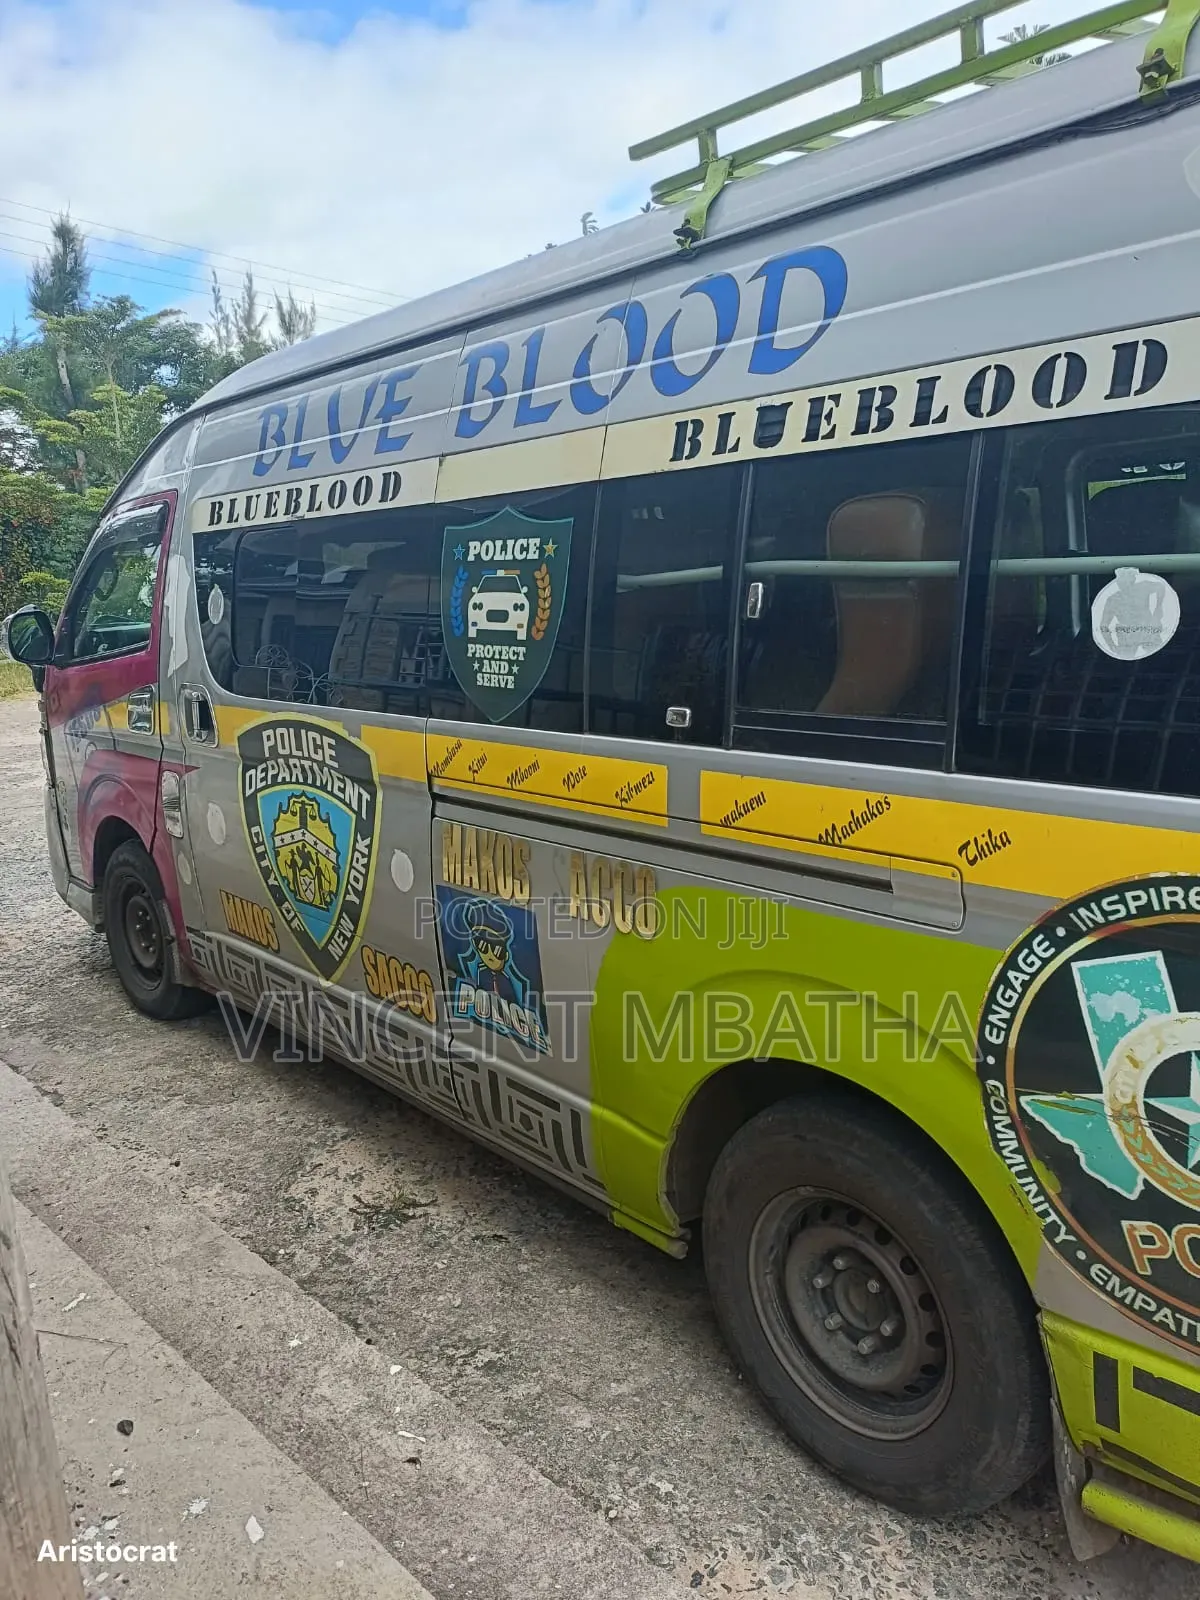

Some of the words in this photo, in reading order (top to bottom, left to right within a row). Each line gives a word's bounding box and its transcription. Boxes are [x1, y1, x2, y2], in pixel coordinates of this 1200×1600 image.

[454, 245, 848, 439] BLOOD
[669, 338, 1168, 462] BLUEBLOOD
[208, 470, 402, 526] BLUEBLOOD
[467, 537, 541, 562] POLICE
[467, 643, 526, 661] PROTECT
[476, 673, 515, 689] SERVE
[482, 660, 509, 674] AND
[262, 727, 339, 769] POLICE
[245, 757, 371, 821] DEPARTMENT
[442, 823, 532, 906] MAKOS
[818, 794, 892, 845] Machakos
[958, 827, 1012, 867] Thika
[251, 825, 280, 889] CITY
[281, 901, 304, 932] OF
[326, 914, 355, 961] NEW
[345, 831, 371, 906] YORK
[361, 944, 439, 1024] SACCO
[455, 980, 549, 1051] POLICE
[984, 933, 1056, 1046] ENGAGE
[984, 1079, 1078, 1244] COMMUNITY
[1089, 1263, 1200, 1343] EMPAT
